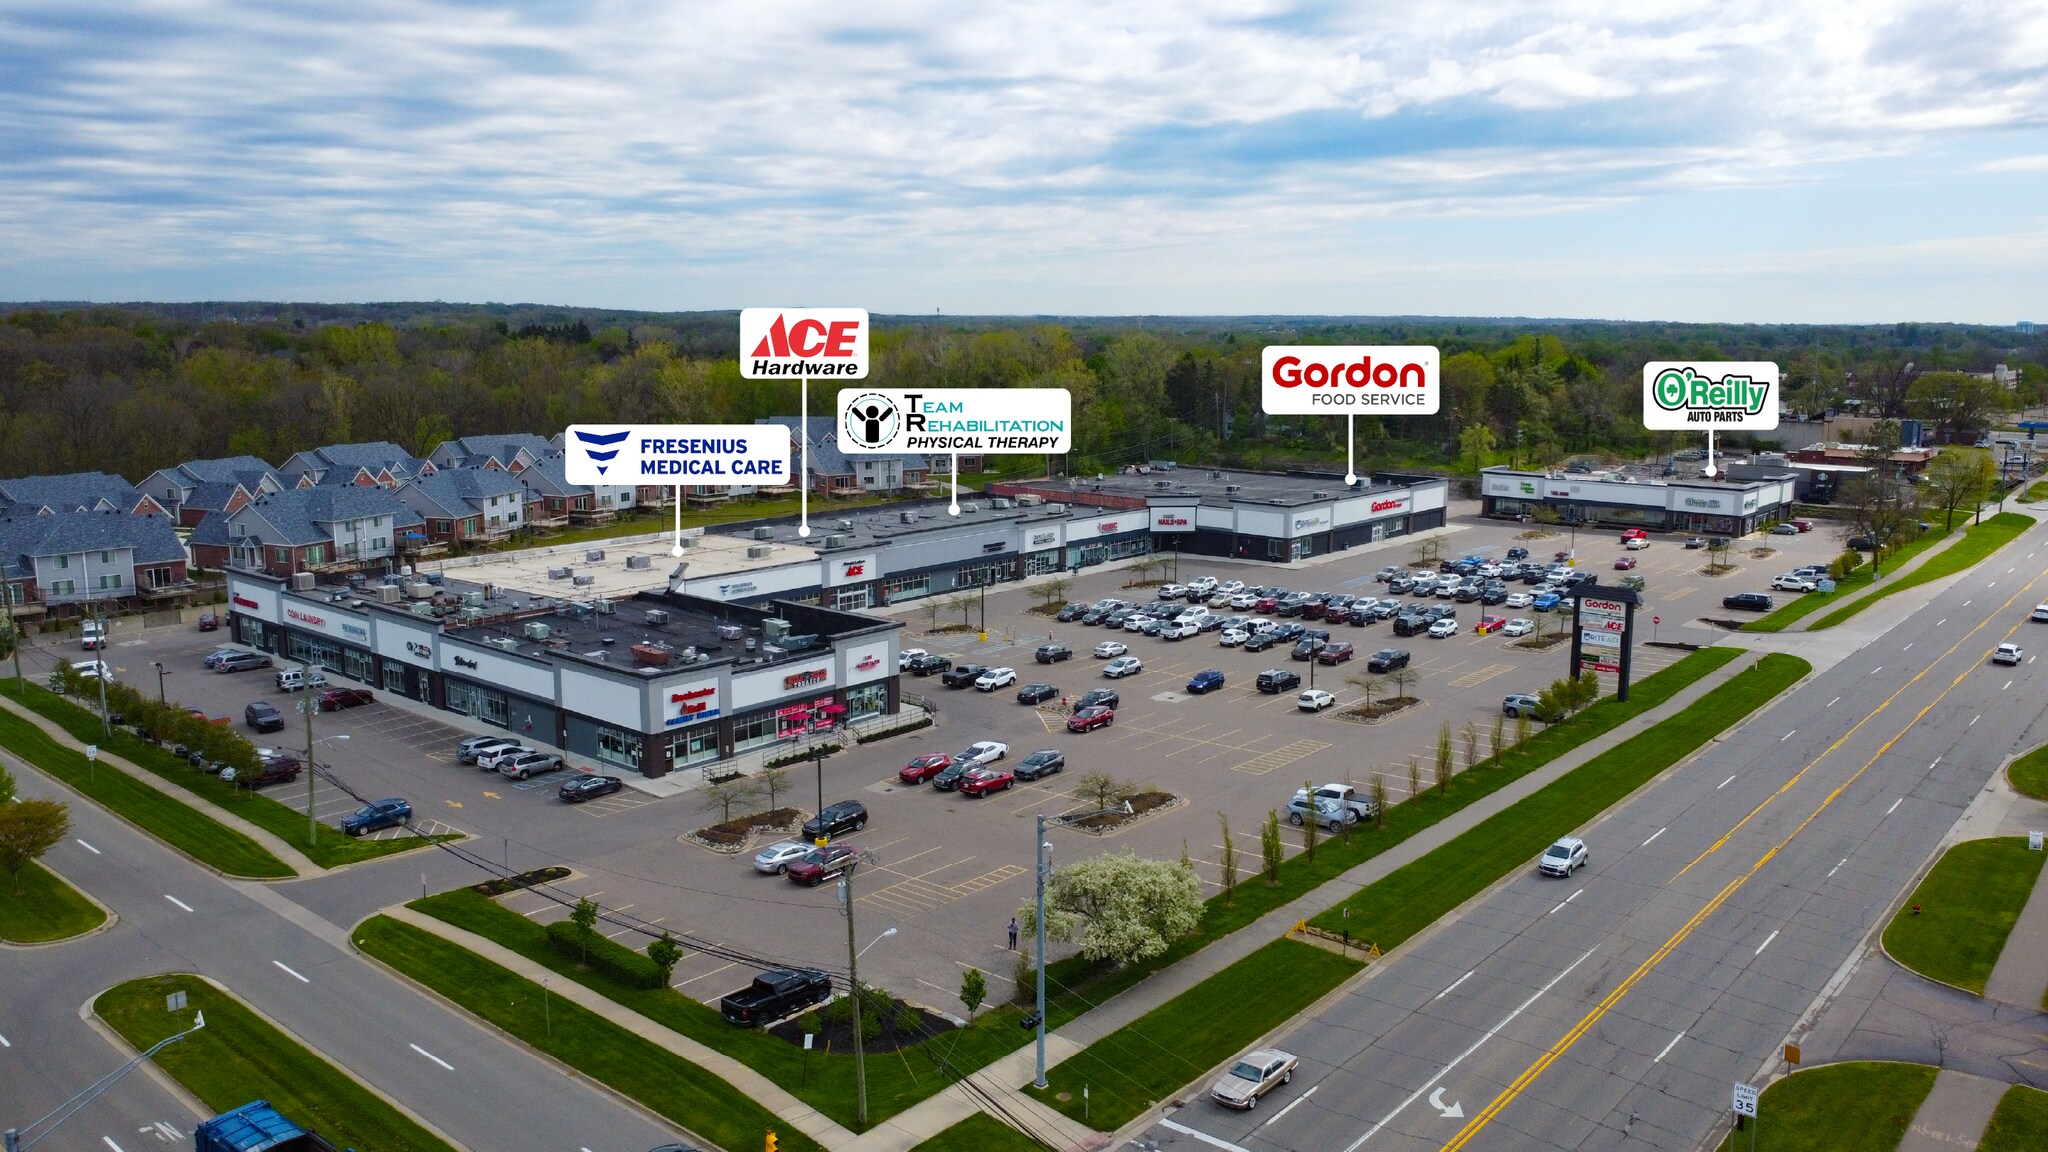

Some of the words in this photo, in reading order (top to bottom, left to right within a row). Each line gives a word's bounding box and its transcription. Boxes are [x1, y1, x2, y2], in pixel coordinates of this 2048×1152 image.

[1371, 499, 1396, 513] Gordon
[845, 565, 864, 577] ACE
[1585, 599, 1621, 611] Gordon
[287, 608, 300, 619] COIN
[1604, 621, 1624, 630] ACE
[1735, 1086, 1757, 1095] SPEED
[1736, 1100, 1754, 1113] 35
